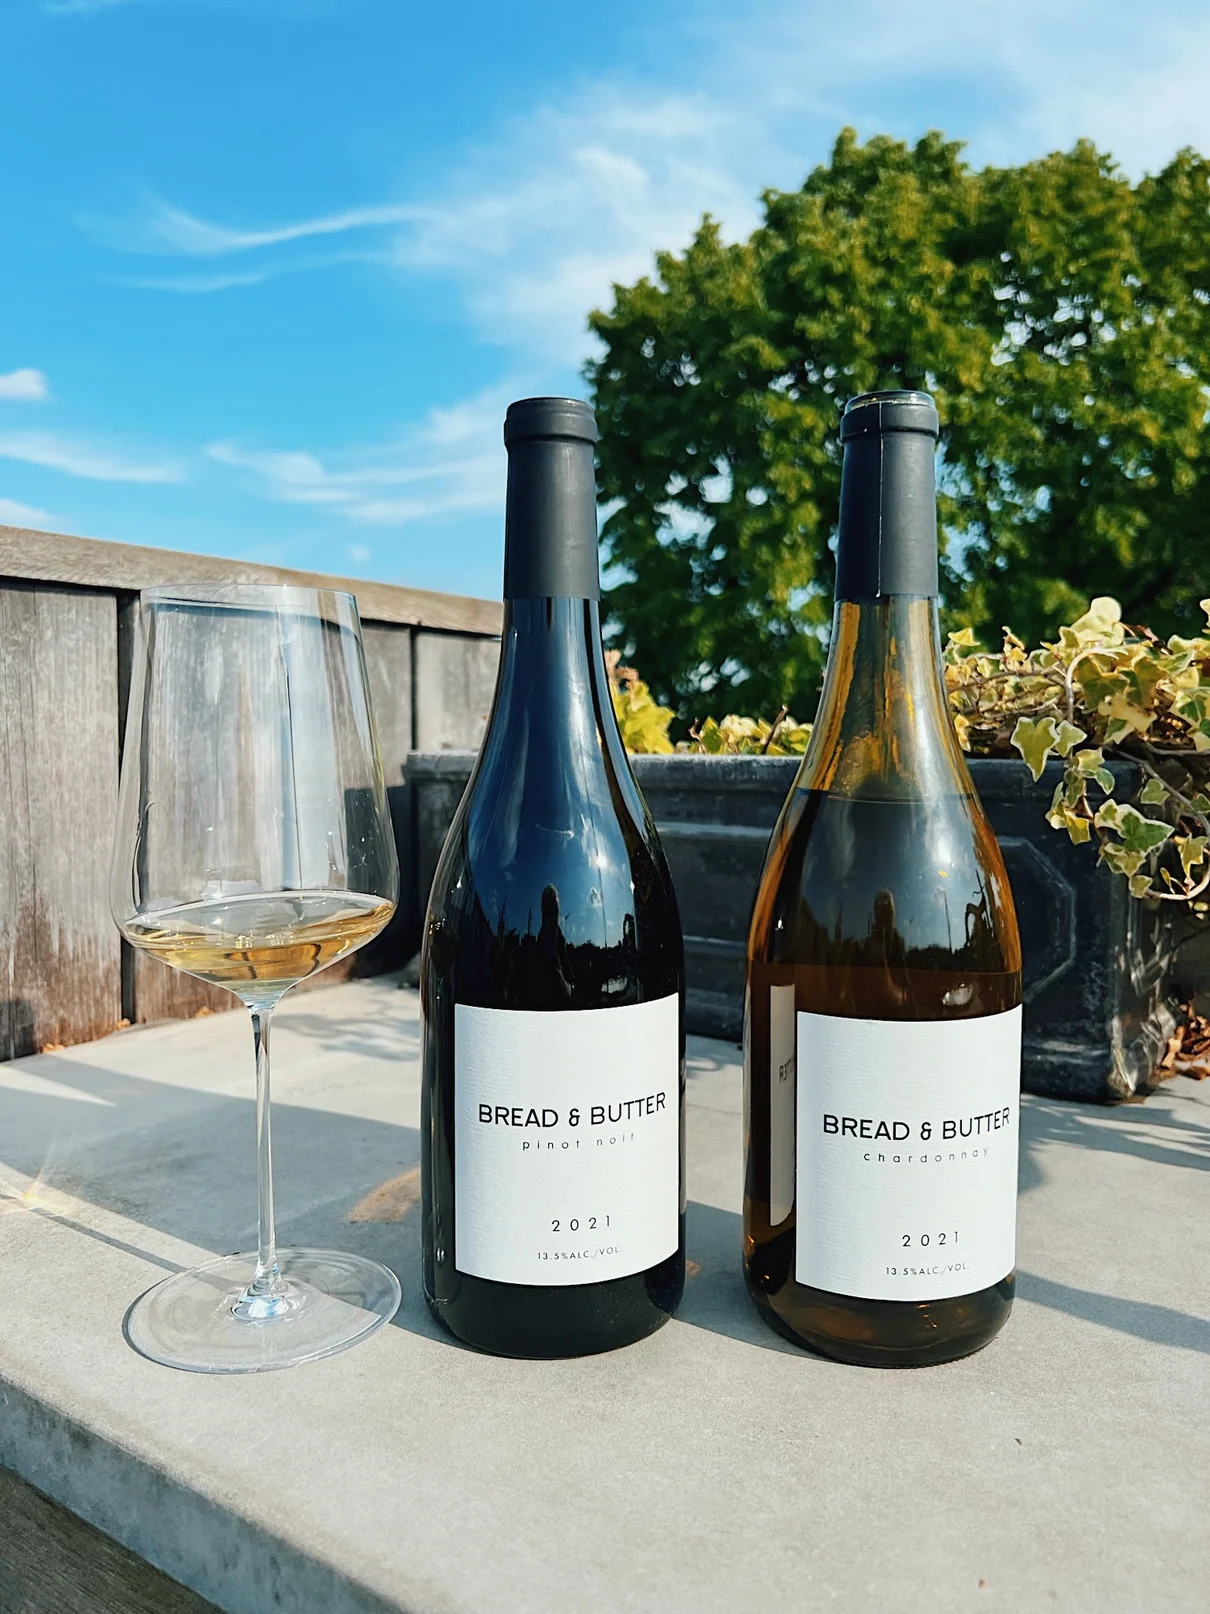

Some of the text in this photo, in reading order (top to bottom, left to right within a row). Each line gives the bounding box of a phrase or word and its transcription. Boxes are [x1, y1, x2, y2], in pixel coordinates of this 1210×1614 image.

[479, 1091, 666, 1128] BREAD & BUTTER
[823, 1106, 1010, 1141] BREAD & BUTTER
[522, 1132, 635, 1151] pinot noir
[863, 1146, 989, 1163] chardonnay
[551, 1215, 610, 1232] 2021
[902, 1231, 958, 1247] 2021
